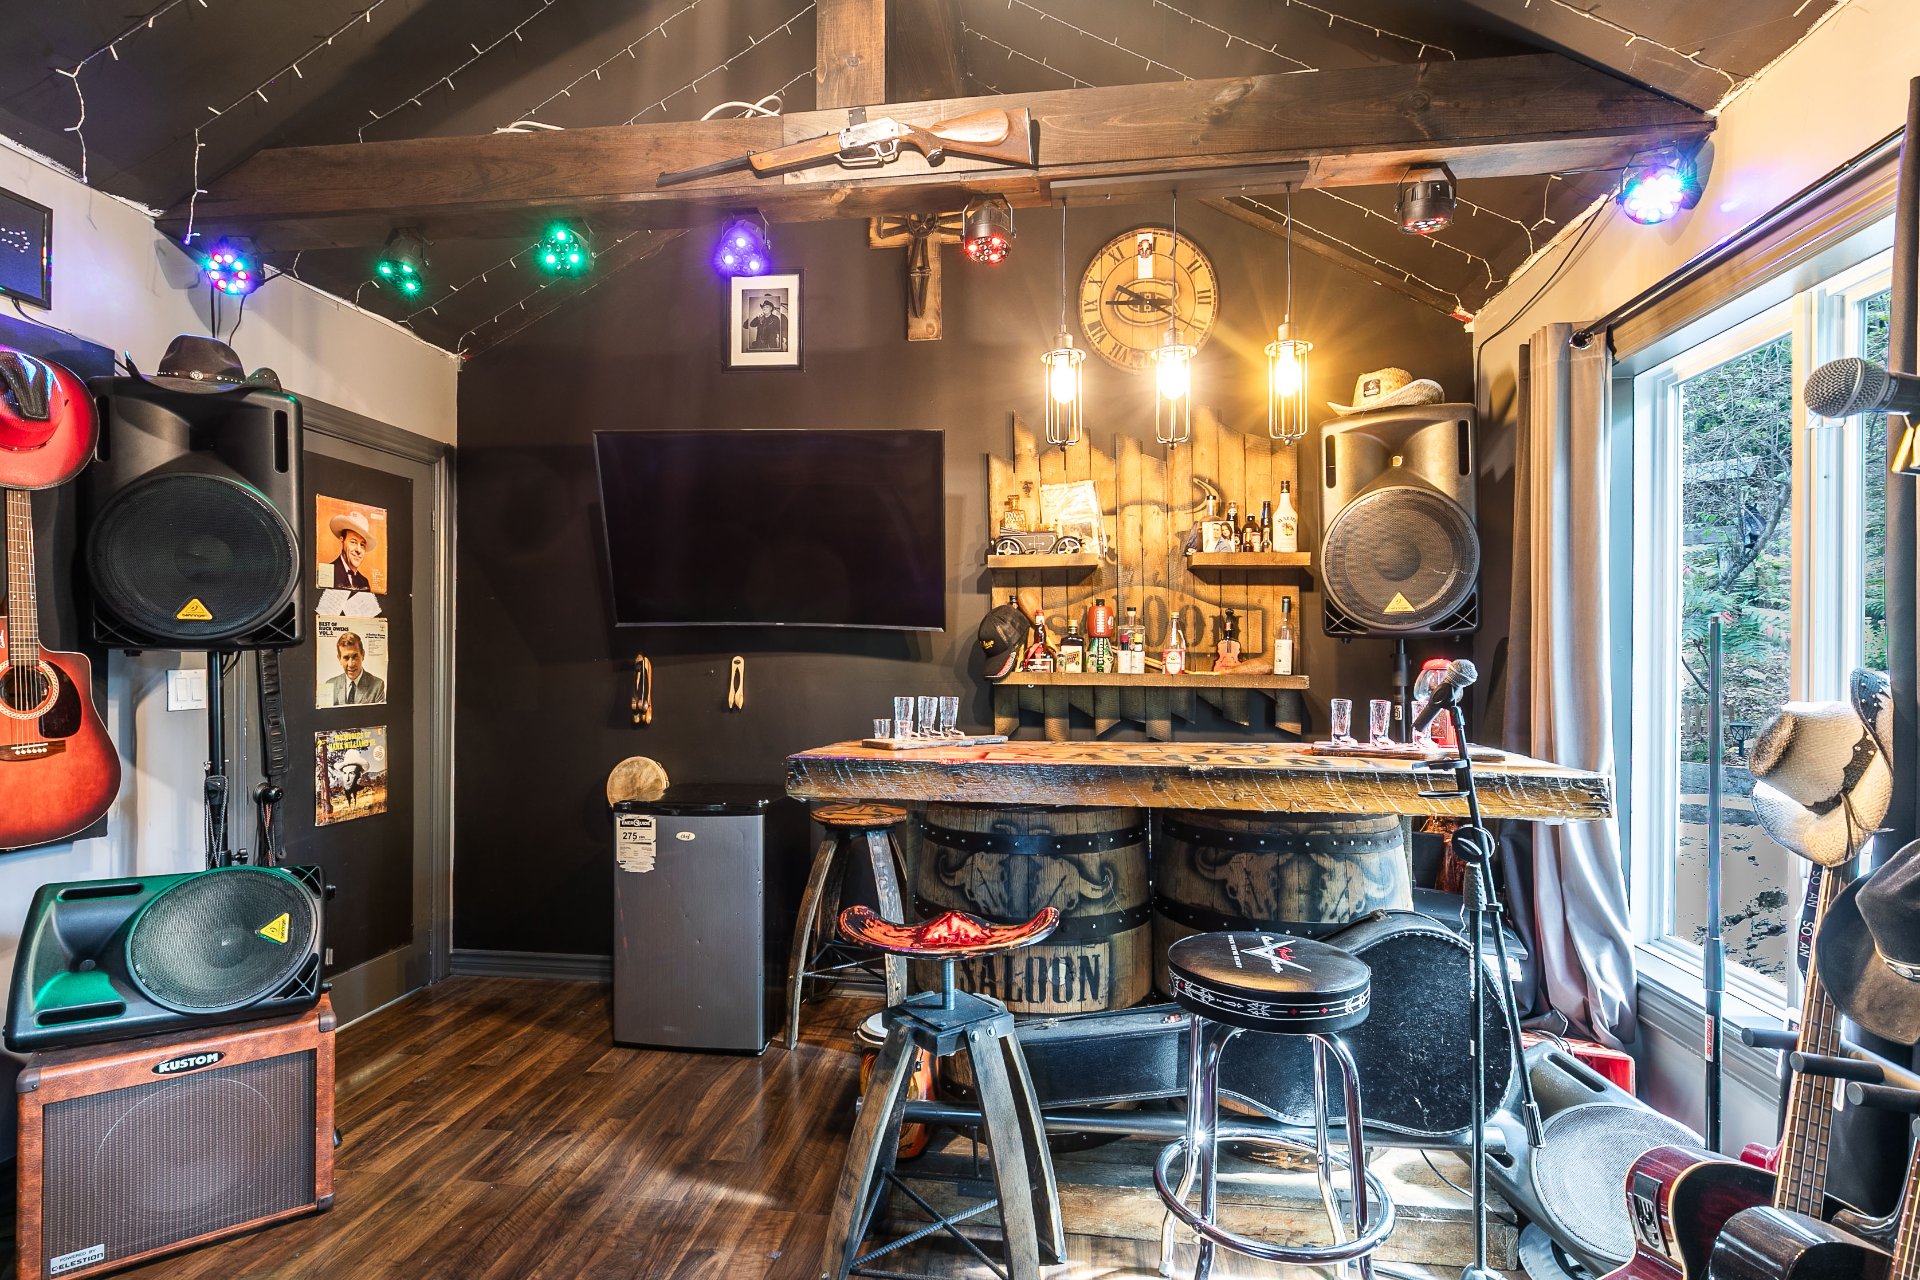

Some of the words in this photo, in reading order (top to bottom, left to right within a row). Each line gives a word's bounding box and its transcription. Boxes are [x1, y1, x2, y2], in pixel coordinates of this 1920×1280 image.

[623, 832, 638, 840] 275
[1796, 920, 1815, 958] SOCAN
[158, 1052, 219, 1073] KUSTOM
[51, 1252, 104, 1272] CELESTION
[60, 1251, 87, 1262] POWERED
